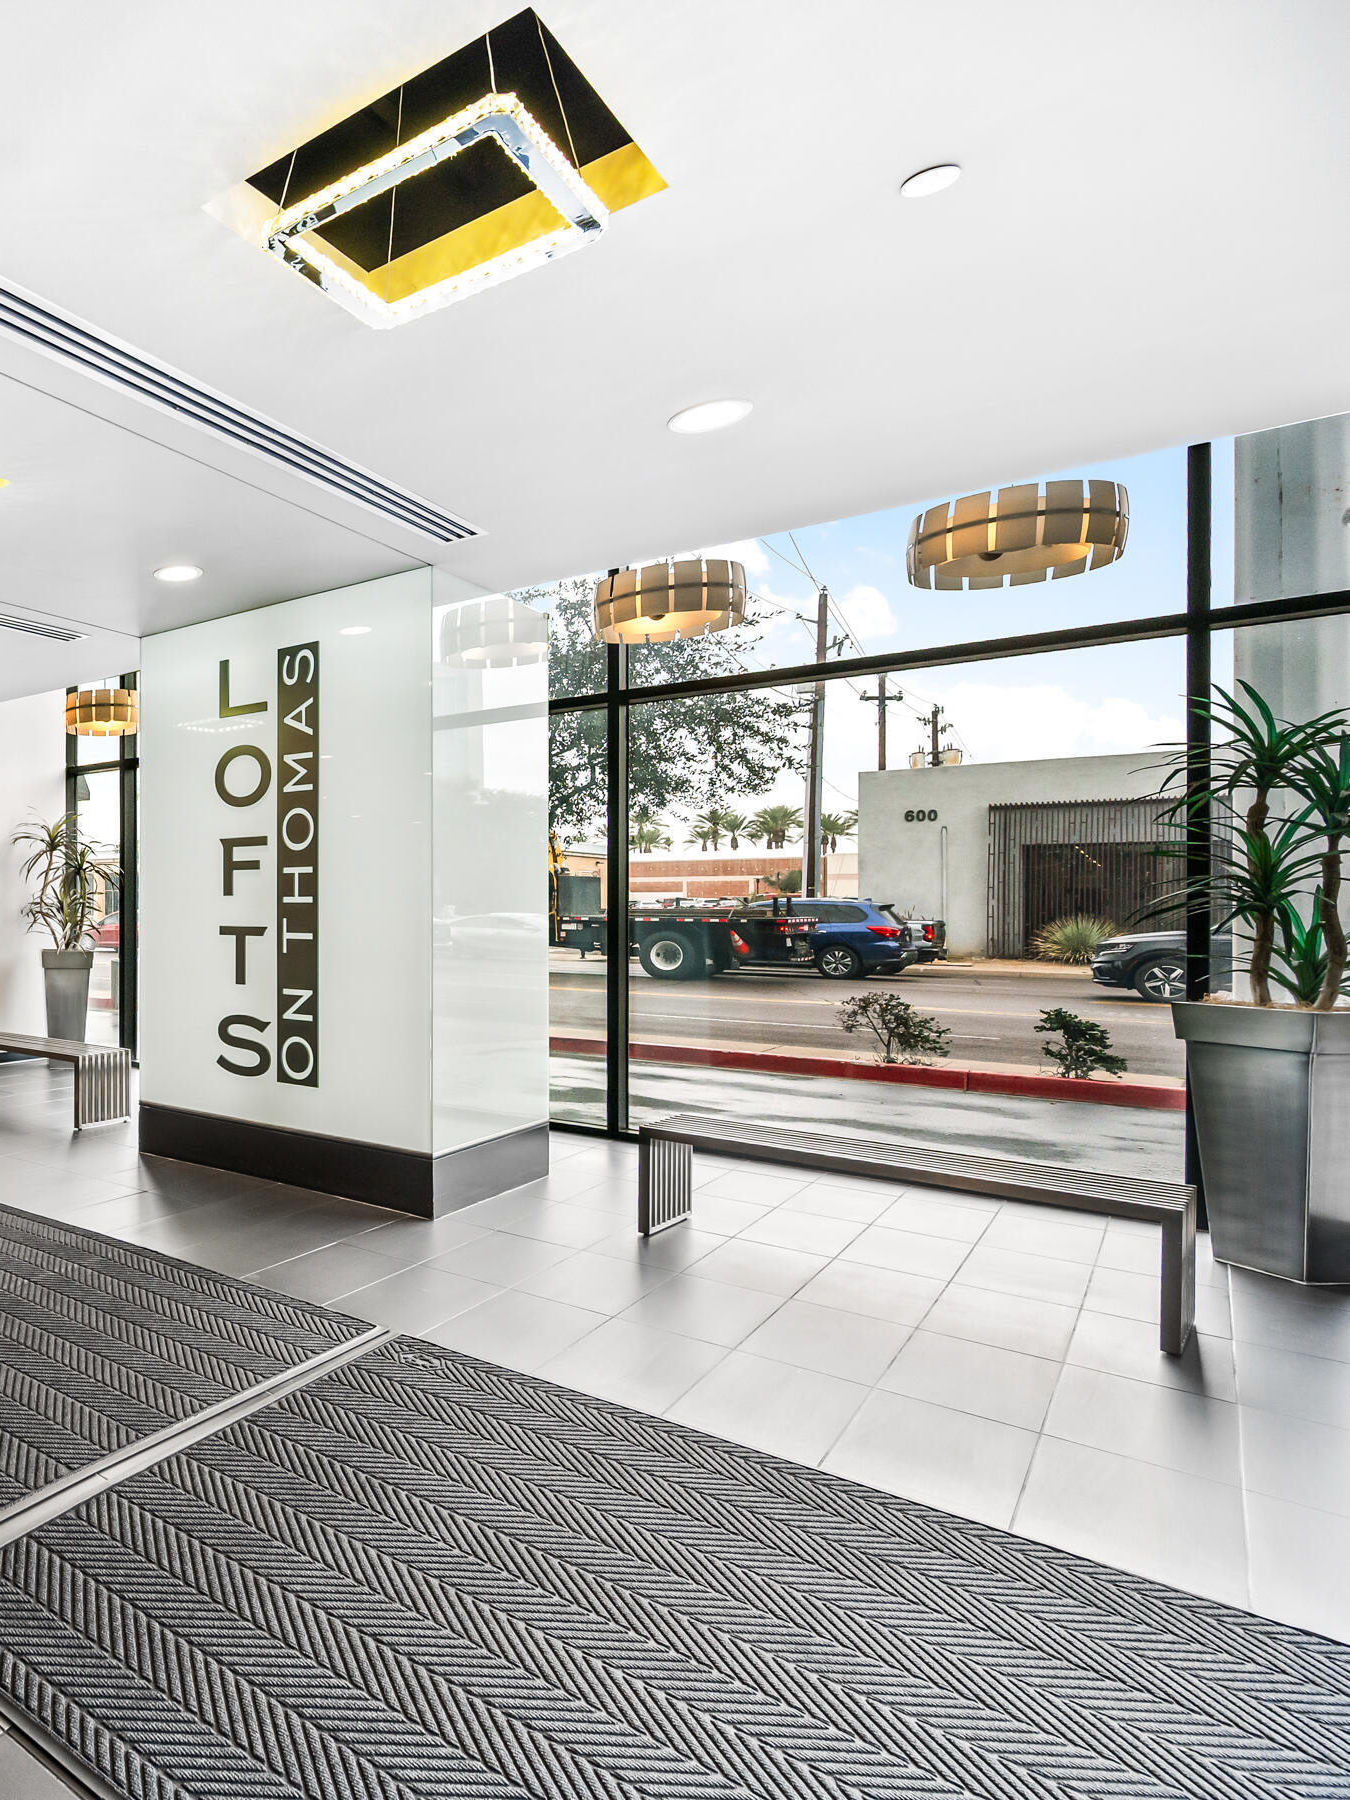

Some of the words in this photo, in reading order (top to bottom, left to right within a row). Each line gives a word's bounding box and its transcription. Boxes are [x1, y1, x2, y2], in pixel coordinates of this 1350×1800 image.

[214, 658, 273, 1078] LOFTS
[281, 648, 316, 954] THOMAS
[904, 809, 938, 822] 600
[281, 987, 315, 1081] ON
